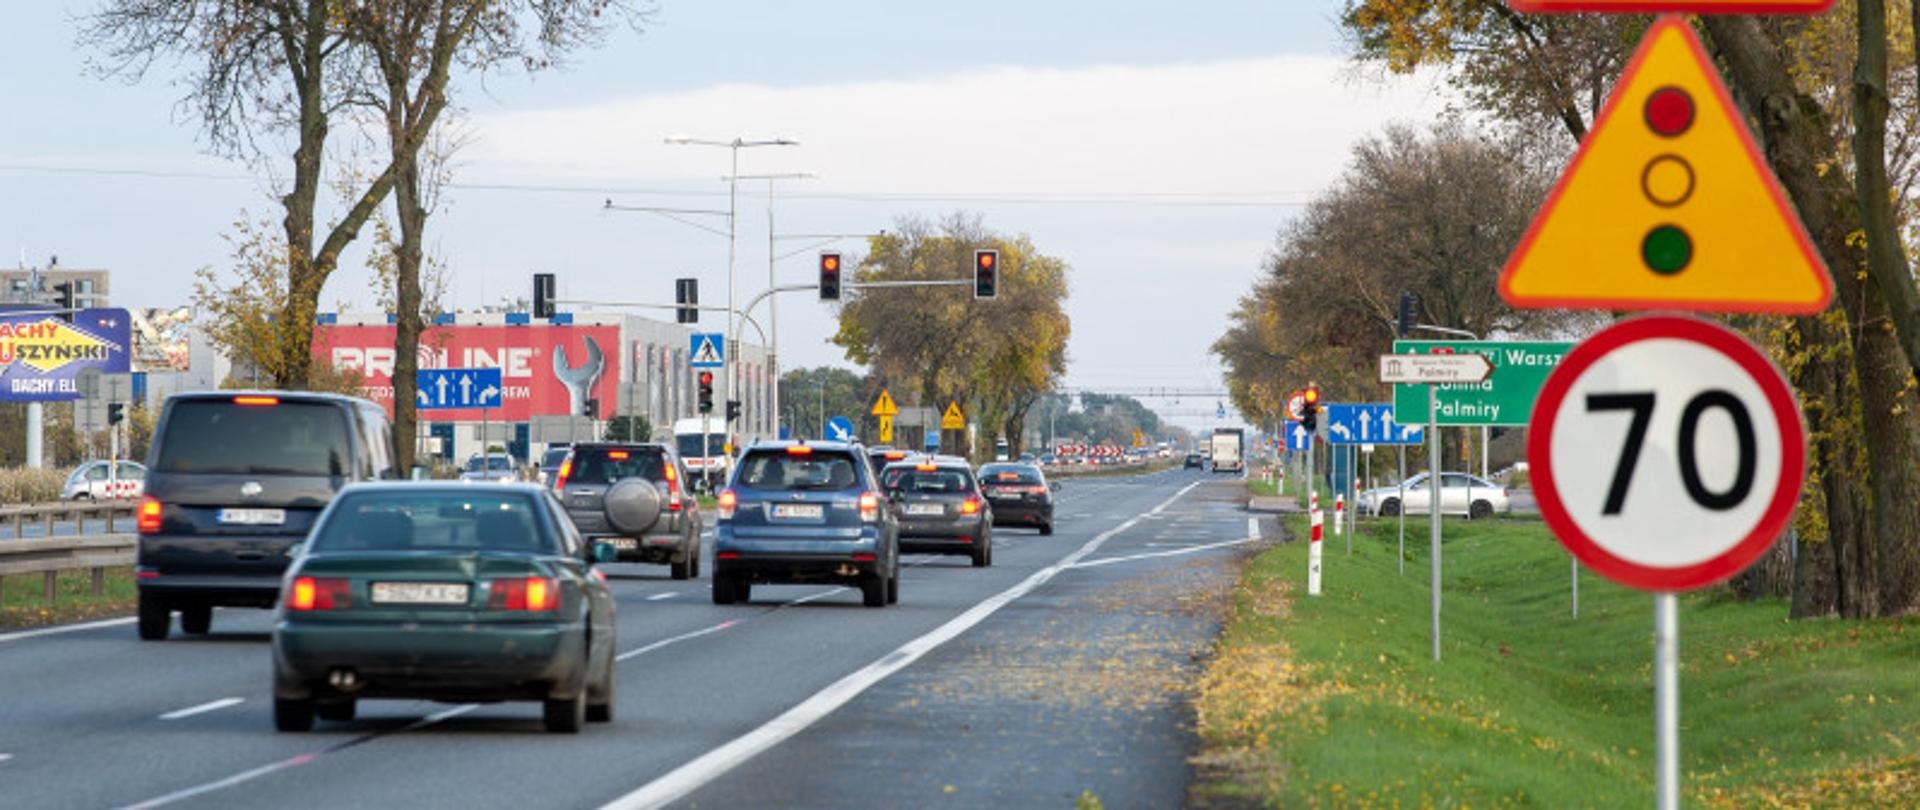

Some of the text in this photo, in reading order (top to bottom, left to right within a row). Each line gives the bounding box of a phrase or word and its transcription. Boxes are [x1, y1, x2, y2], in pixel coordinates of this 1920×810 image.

[1419, 367, 1459, 380] Palmiry
[1434, 399, 1500, 421] Palmiry
[1584, 388, 1758, 516] 70
